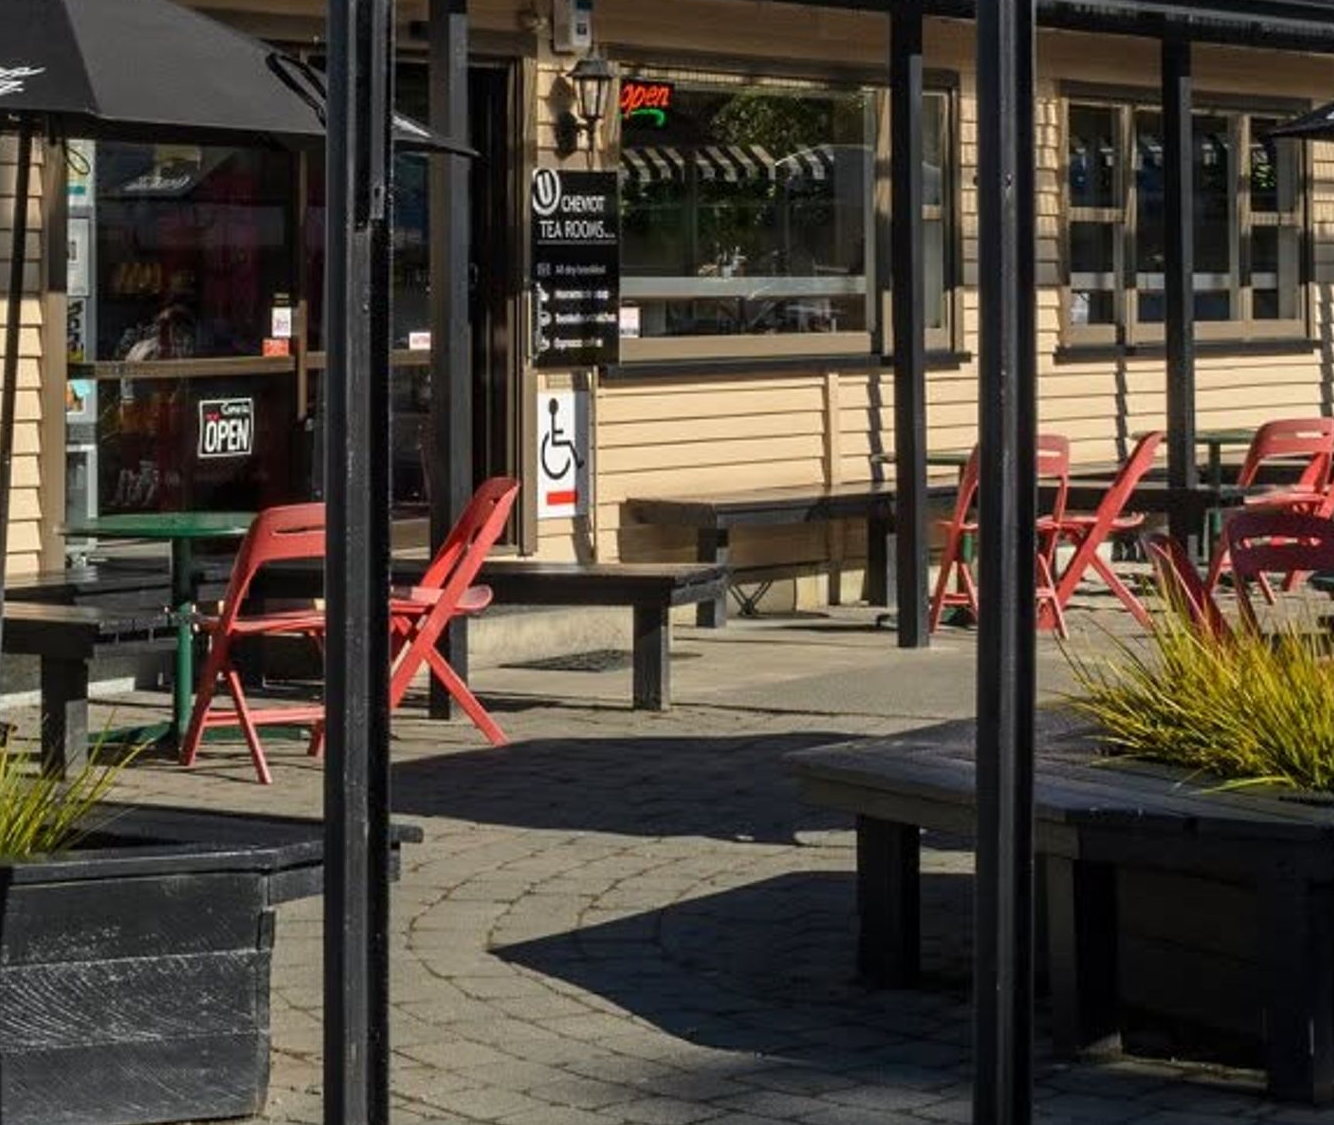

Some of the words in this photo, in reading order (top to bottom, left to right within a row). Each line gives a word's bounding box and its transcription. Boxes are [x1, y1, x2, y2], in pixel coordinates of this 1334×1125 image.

[561, 195, 605, 213] CHEVIOT
[539, 220, 562, 238] TEA
[205, 418, 249, 452] OPEN
